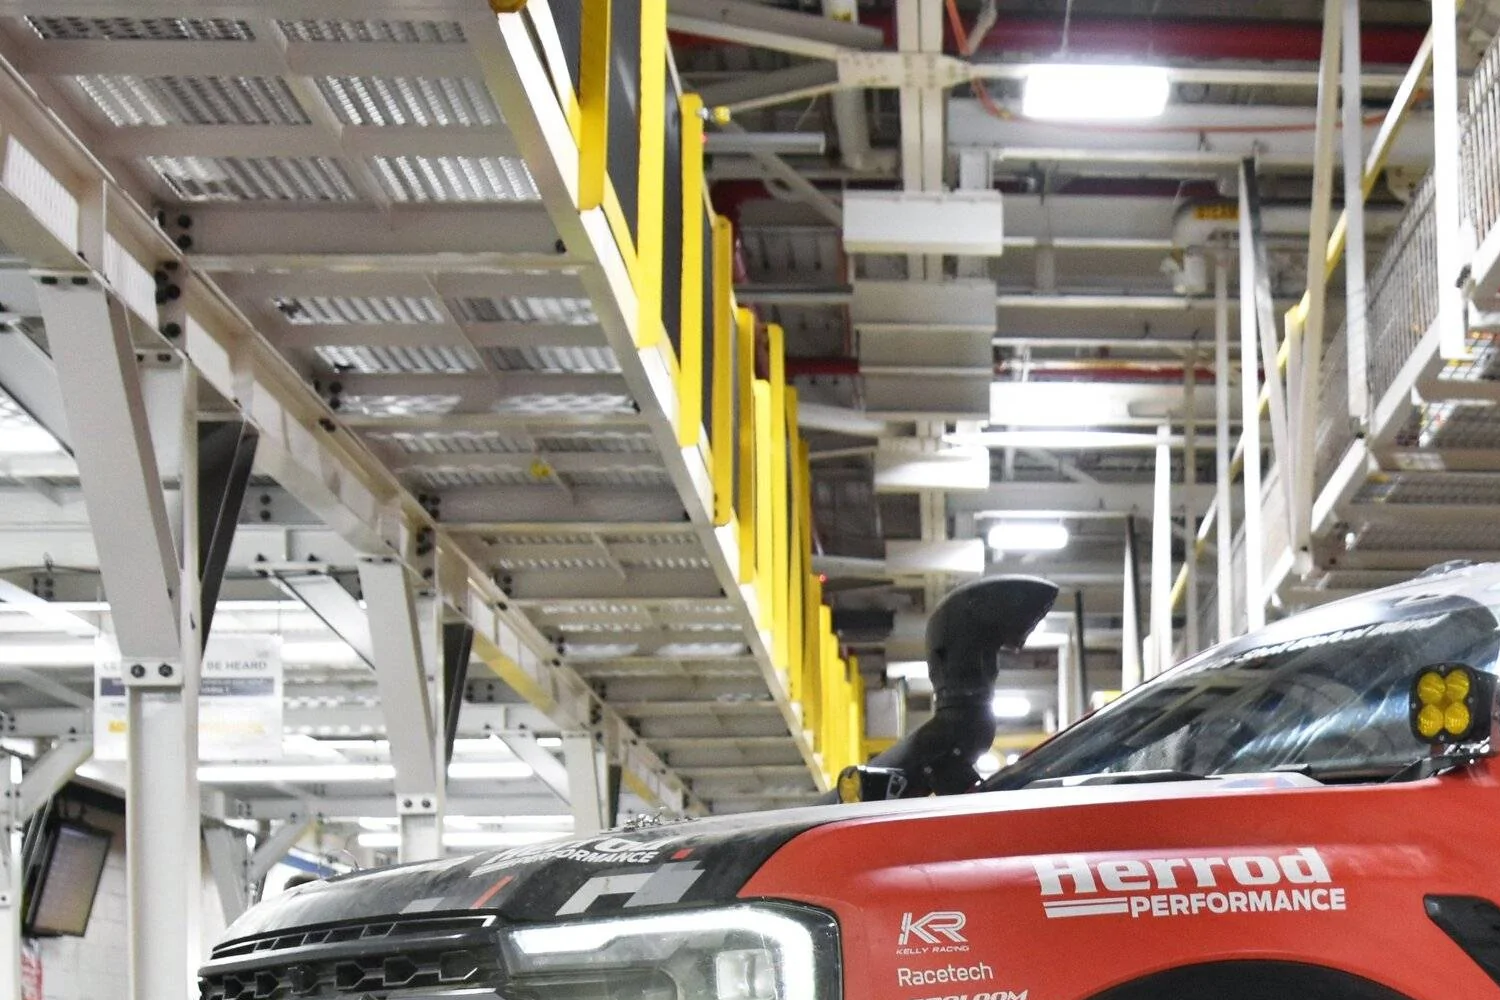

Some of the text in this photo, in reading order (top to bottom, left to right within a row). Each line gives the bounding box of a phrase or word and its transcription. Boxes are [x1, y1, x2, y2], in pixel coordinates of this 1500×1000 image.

[226, 660, 268, 671] HEARD
[1030, 847, 1332, 896] Herrod
[1128, 888, 1347, 918] PERFORMANCE
[898, 911, 969, 946] KR
[896, 945, 970, 955] KELLY RACING
[897, 961, 994, 987] Racetech
